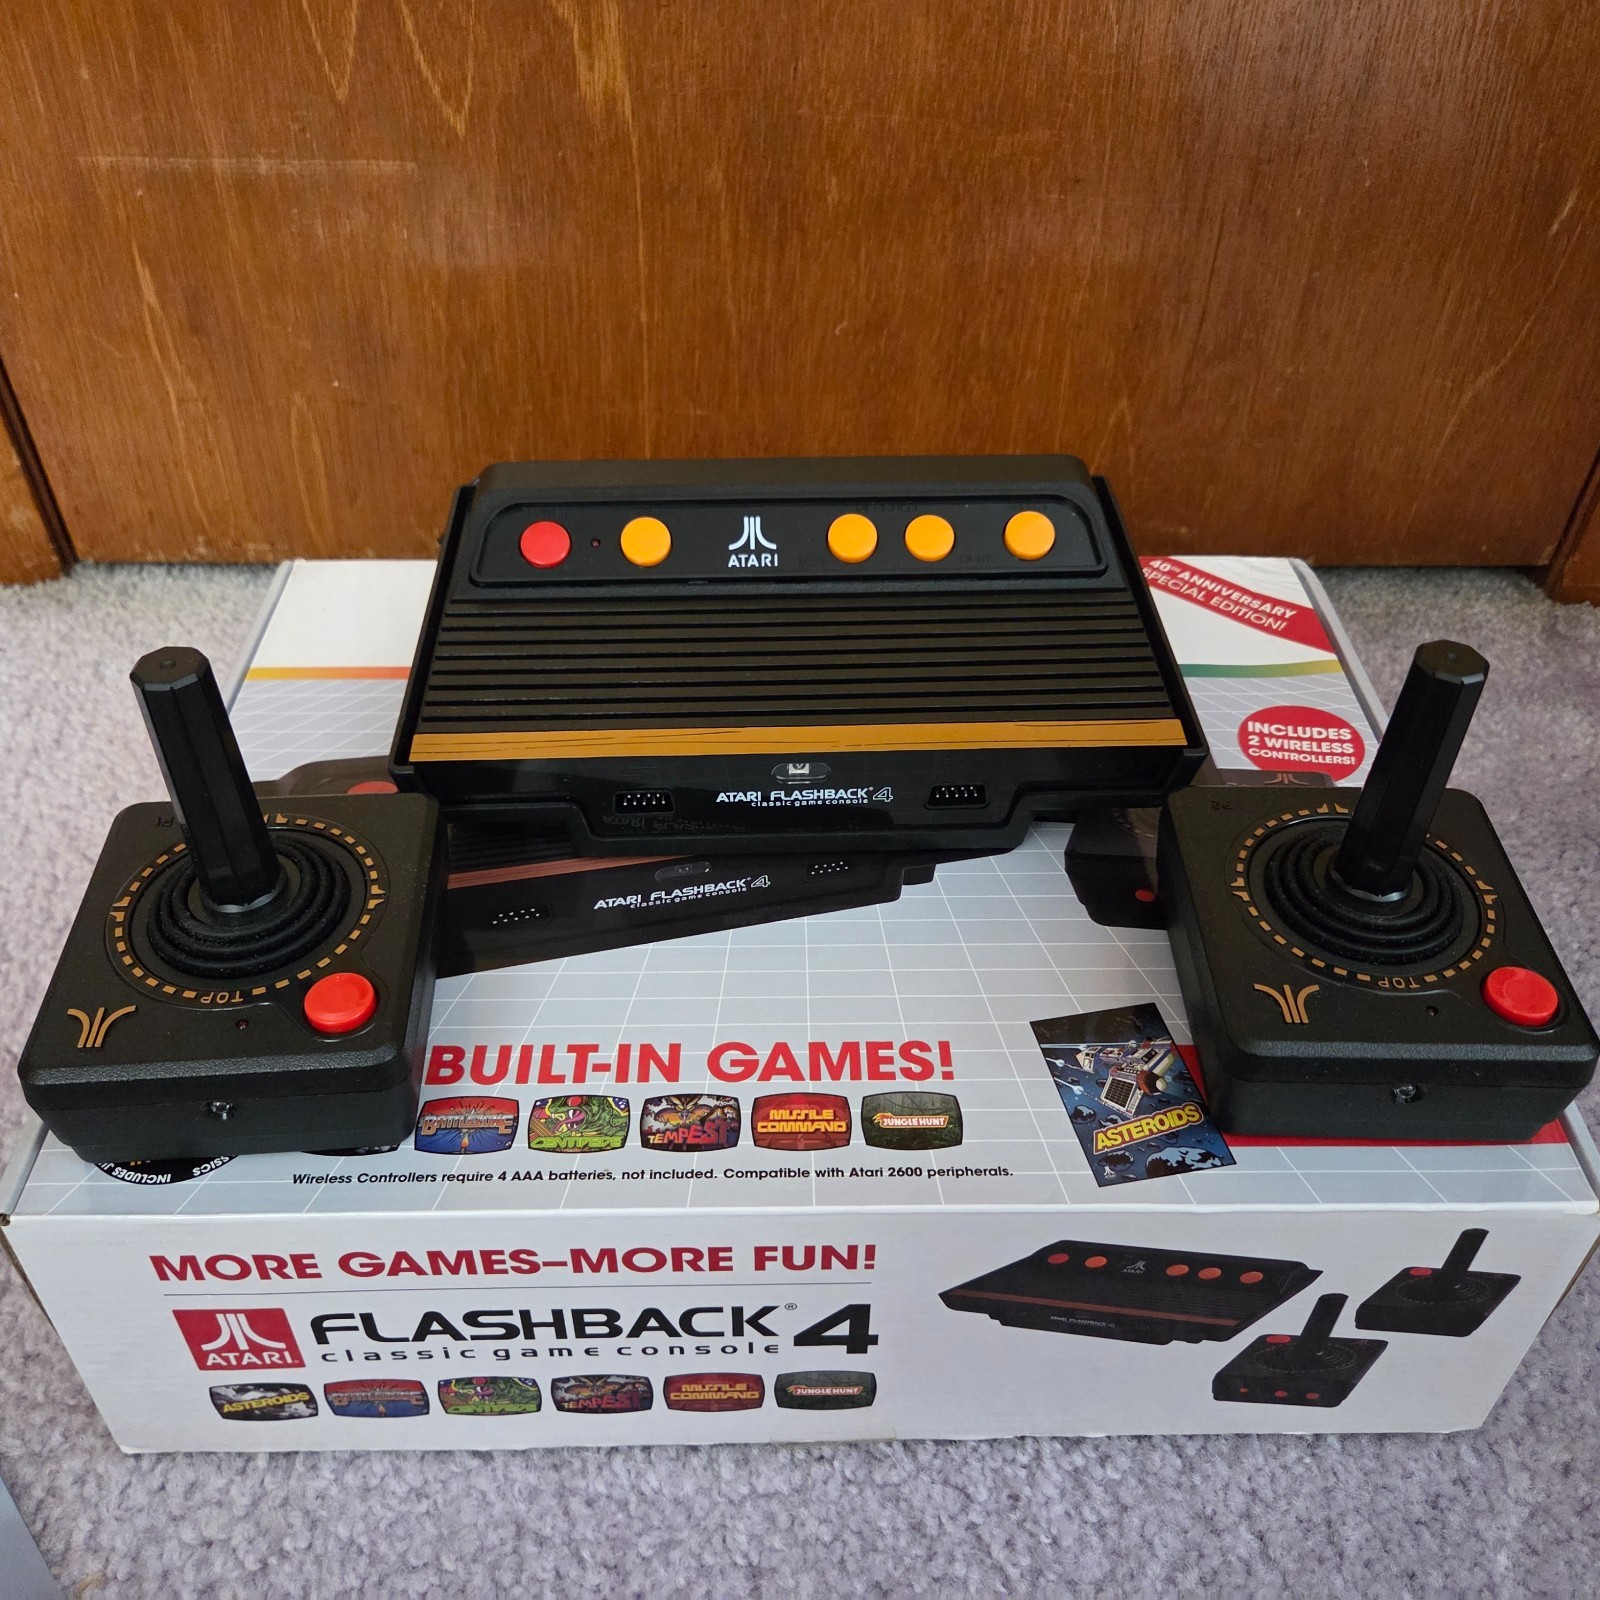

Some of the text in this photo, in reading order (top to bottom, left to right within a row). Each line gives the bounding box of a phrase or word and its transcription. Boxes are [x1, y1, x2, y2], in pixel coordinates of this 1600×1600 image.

[728, 553, 779, 568] ATARI
[1142, 567, 1287, 631] SPECIAL EDITION!
[1177, 570, 1297, 619] ANNIVERSARY
[1247, 721, 1352, 741] INCLUDES
[1247, 735, 1355, 754] 2 WIRELESS
[1247, 748, 1356, 765] CONTROLLERS!
[716, 786, 894, 803] ATARI FLASHBACK 4
[794, 799, 823, 807] game
[826, 797, 869, 805] console
[593, 874, 771, 910] ATARI FLASHBACK 4
[630, 887, 748, 909] classic game console
[1378, 976, 1421, 989] TOP
[200, 990, 244, 1004] TOP
[424, 1039, 956, 1086] BUILT-IN GAMES!
[769, 1108, 835, 1120] MISSILE
[881, 1116, 946, 1127] JUNGLE HUNT
[647, 1117, 729, 1145] TEMPEST
[757, 1120, 849, 1133] COMMAND
[1096, 1103, 1201, 1150] ASTEROIDS
[111, 1166, 172, 1184] INCLUDES
[292, 1165, 1014, 1185] Wireless Controllers require 4 AAA batteries, not included. Compatible with Atari 2600 peripherals.
[149, 1252, 323, 1281] MORE
[754, 1244, 877, 1271] FUN!
[793, 1303, 880, 1355] 4
[206, 1351, 295, 1367] ATARI
[321, 1341, 780, 1362] classic game console
[670, 1391, 760, 1401] COMMAND
[795, 1386, 863, 1396] JUNGLE HUNT
[222, 1391, 312, 1414] ASTEROIDS
